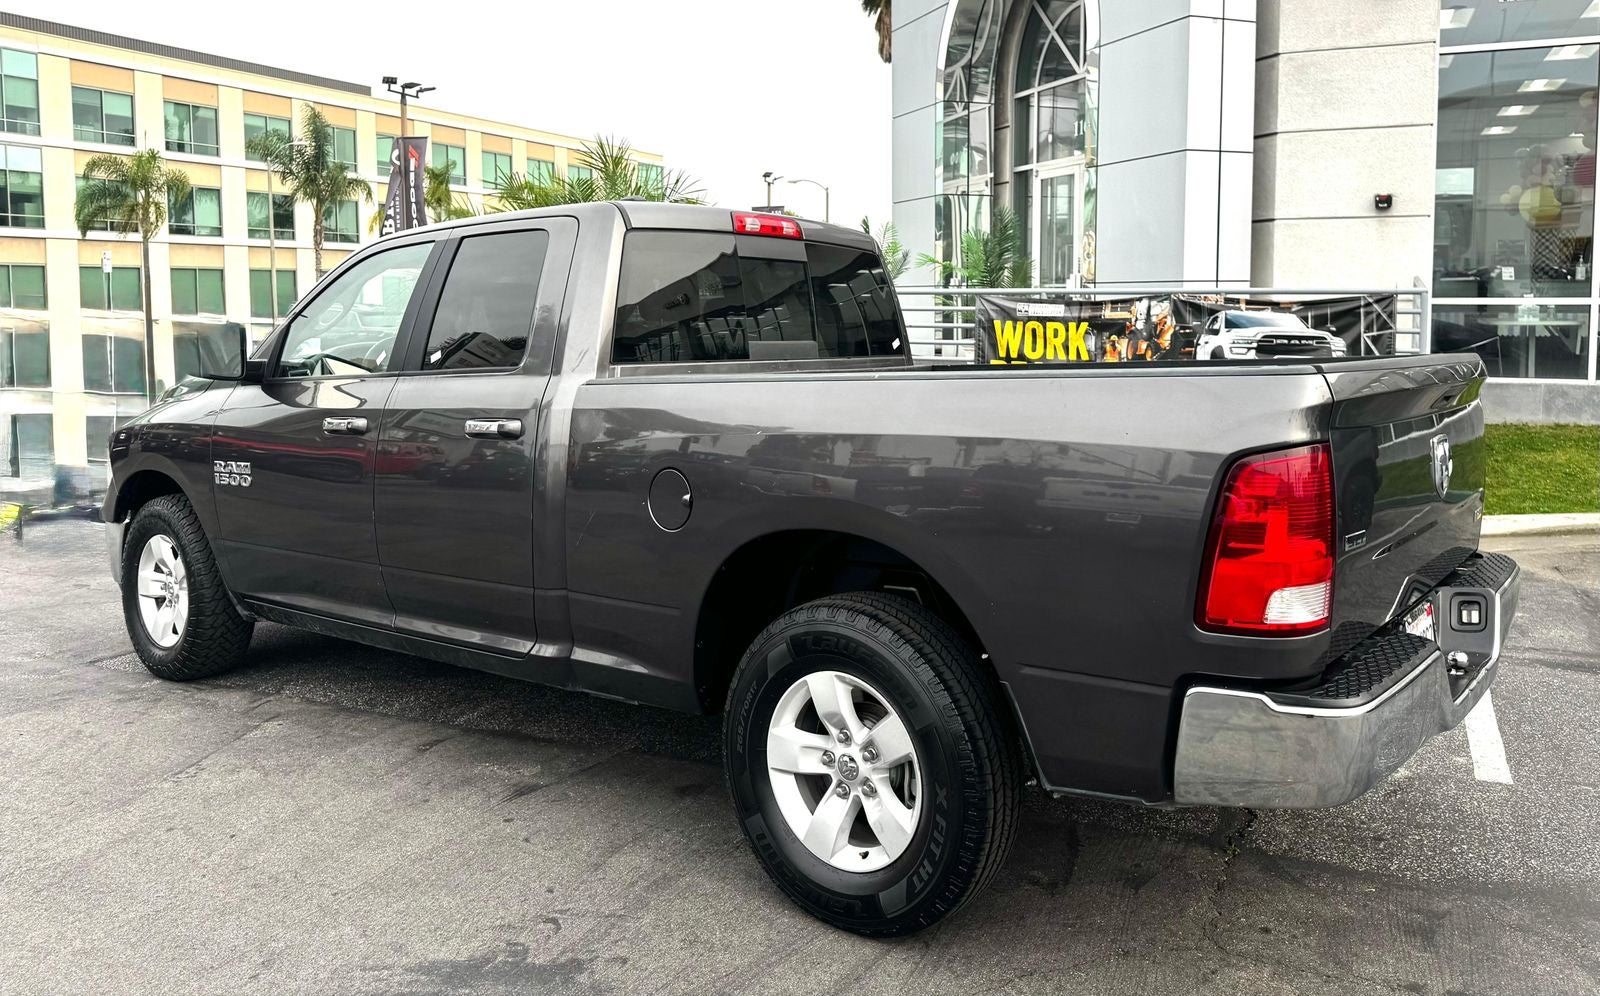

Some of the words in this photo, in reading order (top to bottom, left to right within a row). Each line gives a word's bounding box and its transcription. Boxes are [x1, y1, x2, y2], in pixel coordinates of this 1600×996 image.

[993, 319, 1090, 361] WORK
[214, 460, 251, 474] RAM
[214, 473, 251, 487] 1500
[935, 782, 949, 811] X
[929, 813, 947, 861] FIT
[912, 857, 934, 894] HT
